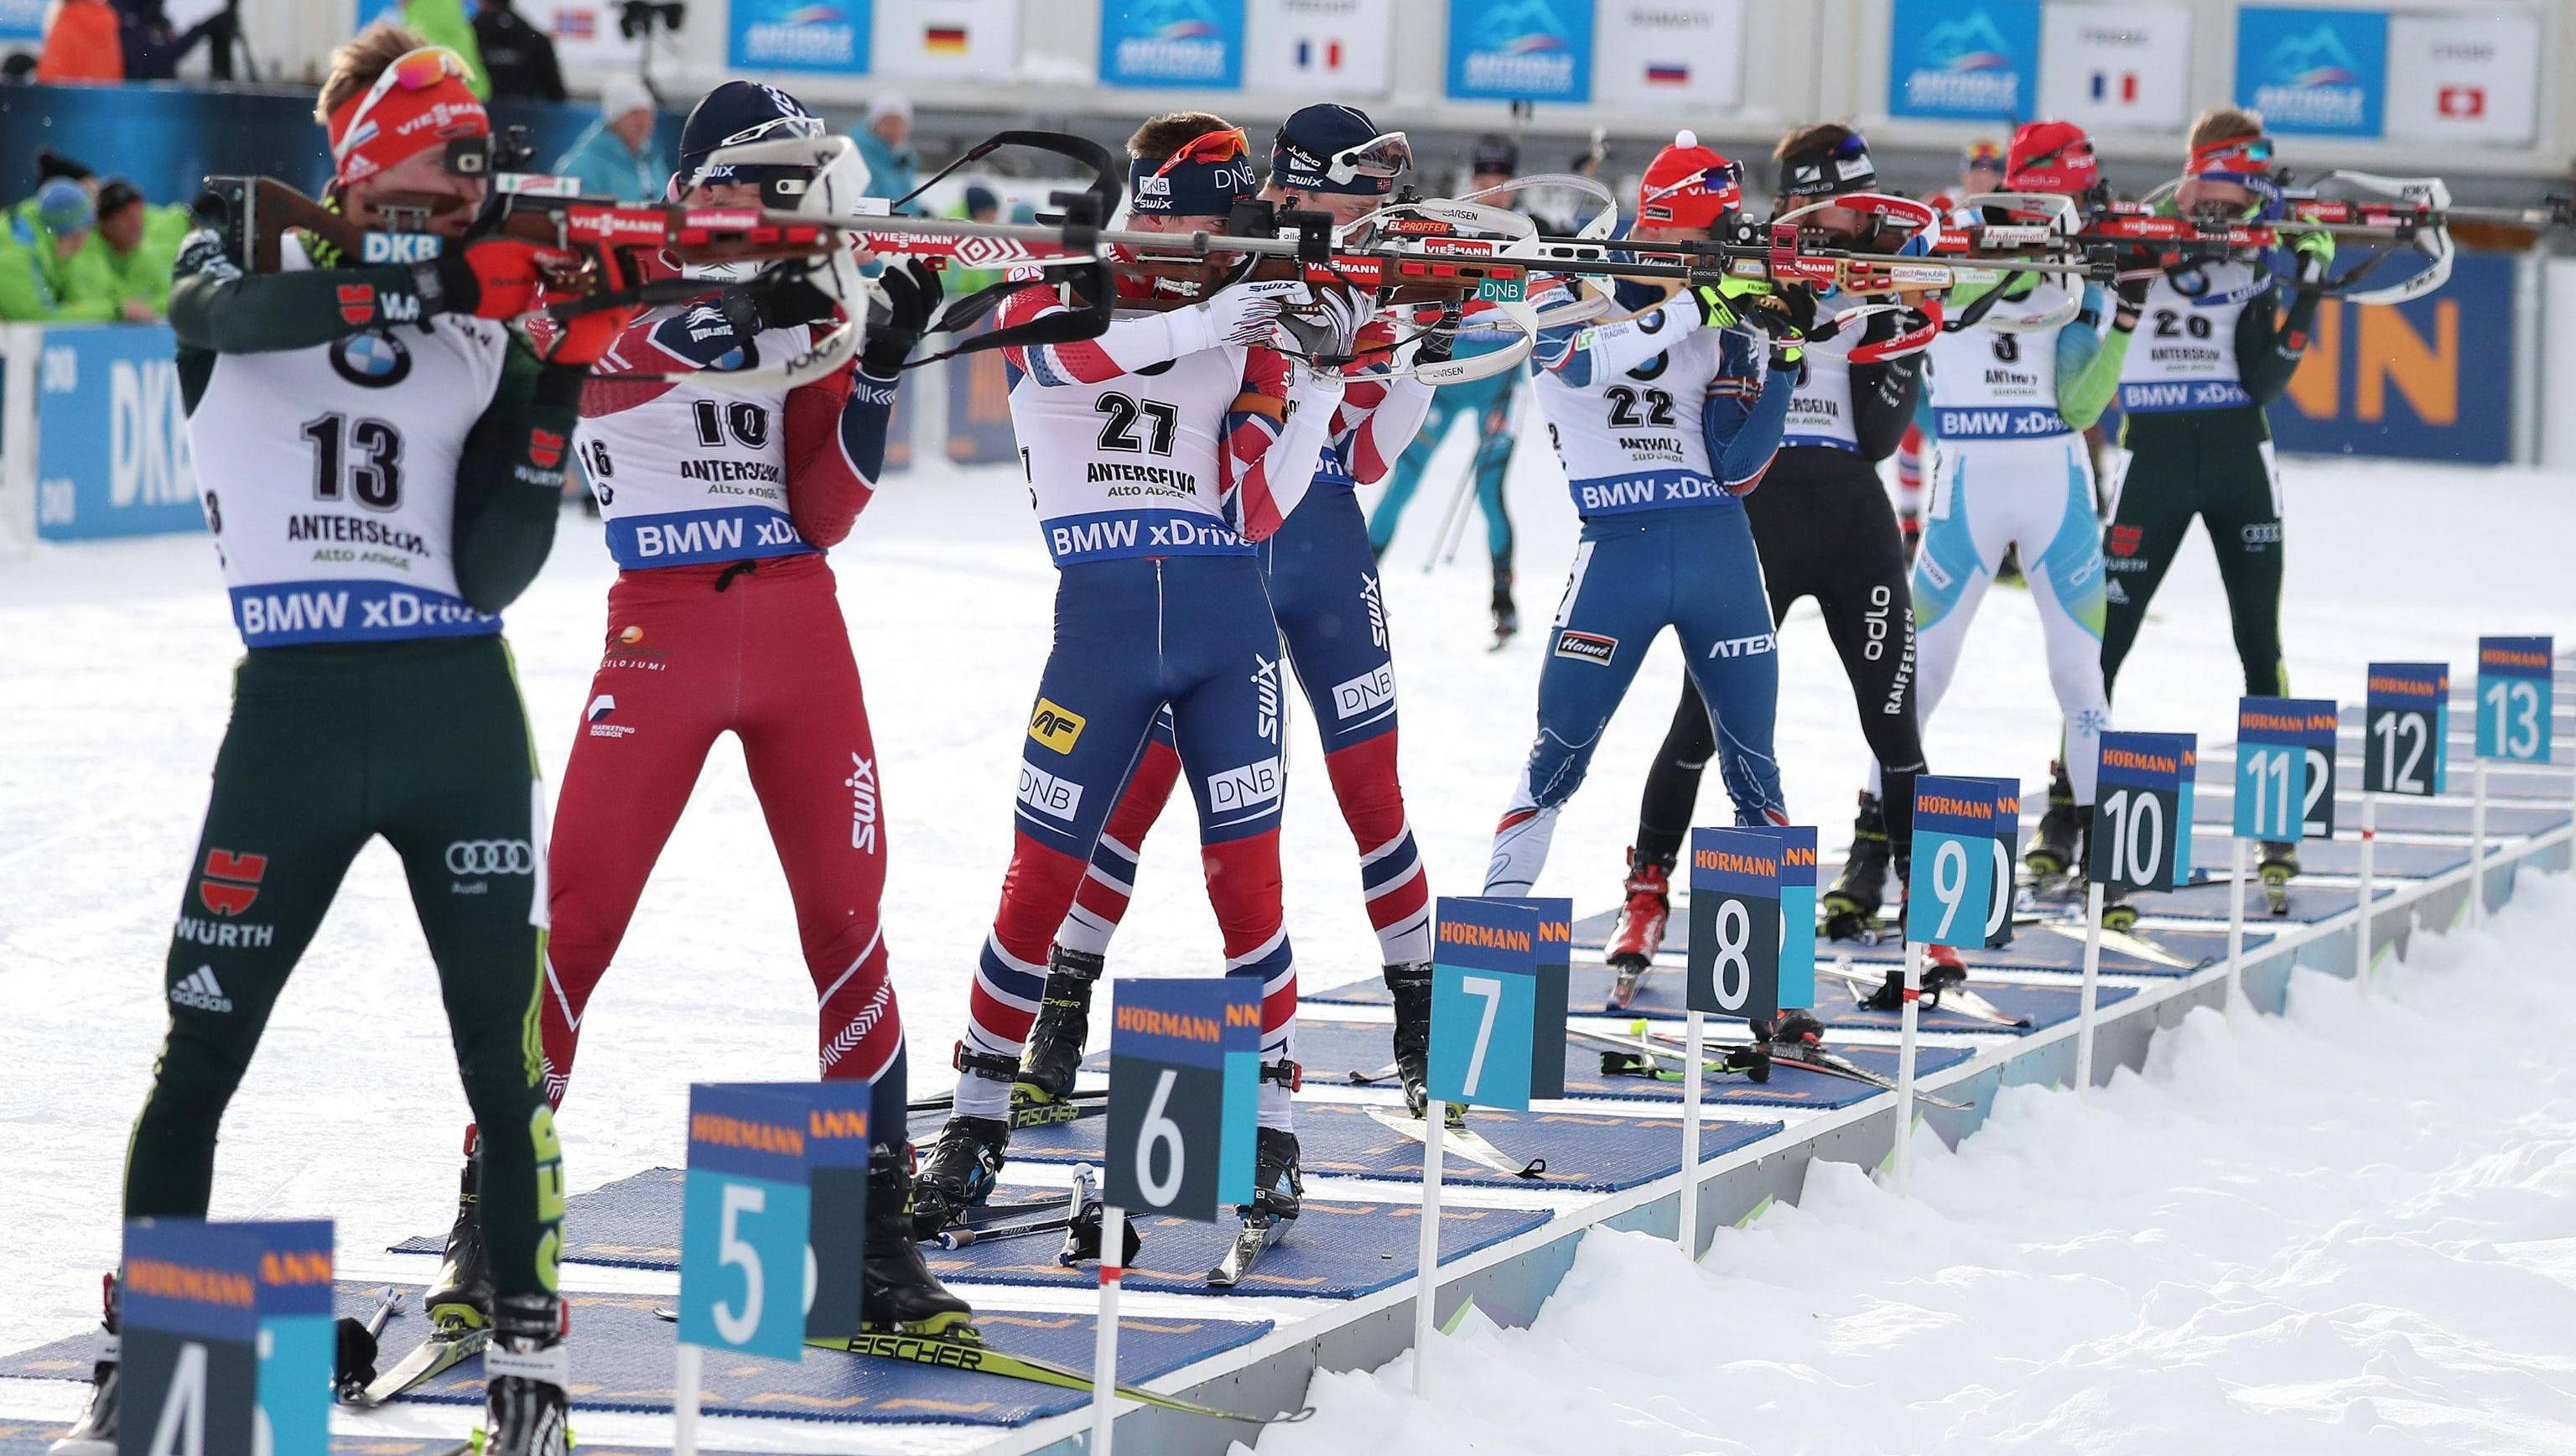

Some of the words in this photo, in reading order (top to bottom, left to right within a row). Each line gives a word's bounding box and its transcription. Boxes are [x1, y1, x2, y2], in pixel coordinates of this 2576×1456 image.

[1215, 161, 1256, 194] DNB
[364, 232, 439, 263] DKB
[872, 232, 953, 248] VIESSMANN
[1484, 279, 1519, 302] DNB
[1603, 384, 1678, 429] 22
[1788, 398, 1840, 418] ERSELVA
[2125, 384, 2189, 408] BMW
[1094, 391, 1179, 457] 27
[1942, 411, 2009, 435] BMW
[299, 411, 405, 513] 13
[1087, 462, 1197, 496] ANTERSELVA
[1107, 486, 1141, 497] ALTO
[1582, 479, 1655, 509] BMW
[636, 517, 744, 558] BMW
[1052, 519, 1139, 556] BMW
[242, 591, 349, 636] BMW
[1358, 571, 1389, 653] swix
[1863, 585, 1891, 662] odlo
[1708, 632, 1777, 659] ATEX
[1883, 607, 1916, 715] RAIFFEISEN
[1249, 653, 1279, 746] swix
[1342, 664, 1394, 713] DNB
[2485, 681, 2540, 759] 13
[2374, 710, 2428, 795] 12
[844, 751, 876, 855] swix
[1018, 766, 1071, 811] DNB
[1216, 762, 1277, 806] DNB
[2246, 750, 2292, 838] 11
[1917, 793, 1993, 820] HÖRMANN
[2102, 789, 2164, 887] 10
[1695, 849, 1777, 878] HÖRMANN
[1933, 840, 1968, 940] 9
[176, 916, 274, 949] WÜRTH
[1439, 920, 1532, 954] HÖRMANN
[1712, 898, 1751, 1011] 8
[1116, 1004, 1220, 1043] HÖRMANN
[1462, 975, 1502, 1097] 7
[1016, 1104, 1081, 1130] FISCHER
[1135, 1069, 1185, 1207] 6
[712, 1183, 766, 1344] 5
[846, 1334, 984, 1371] FISCHER
